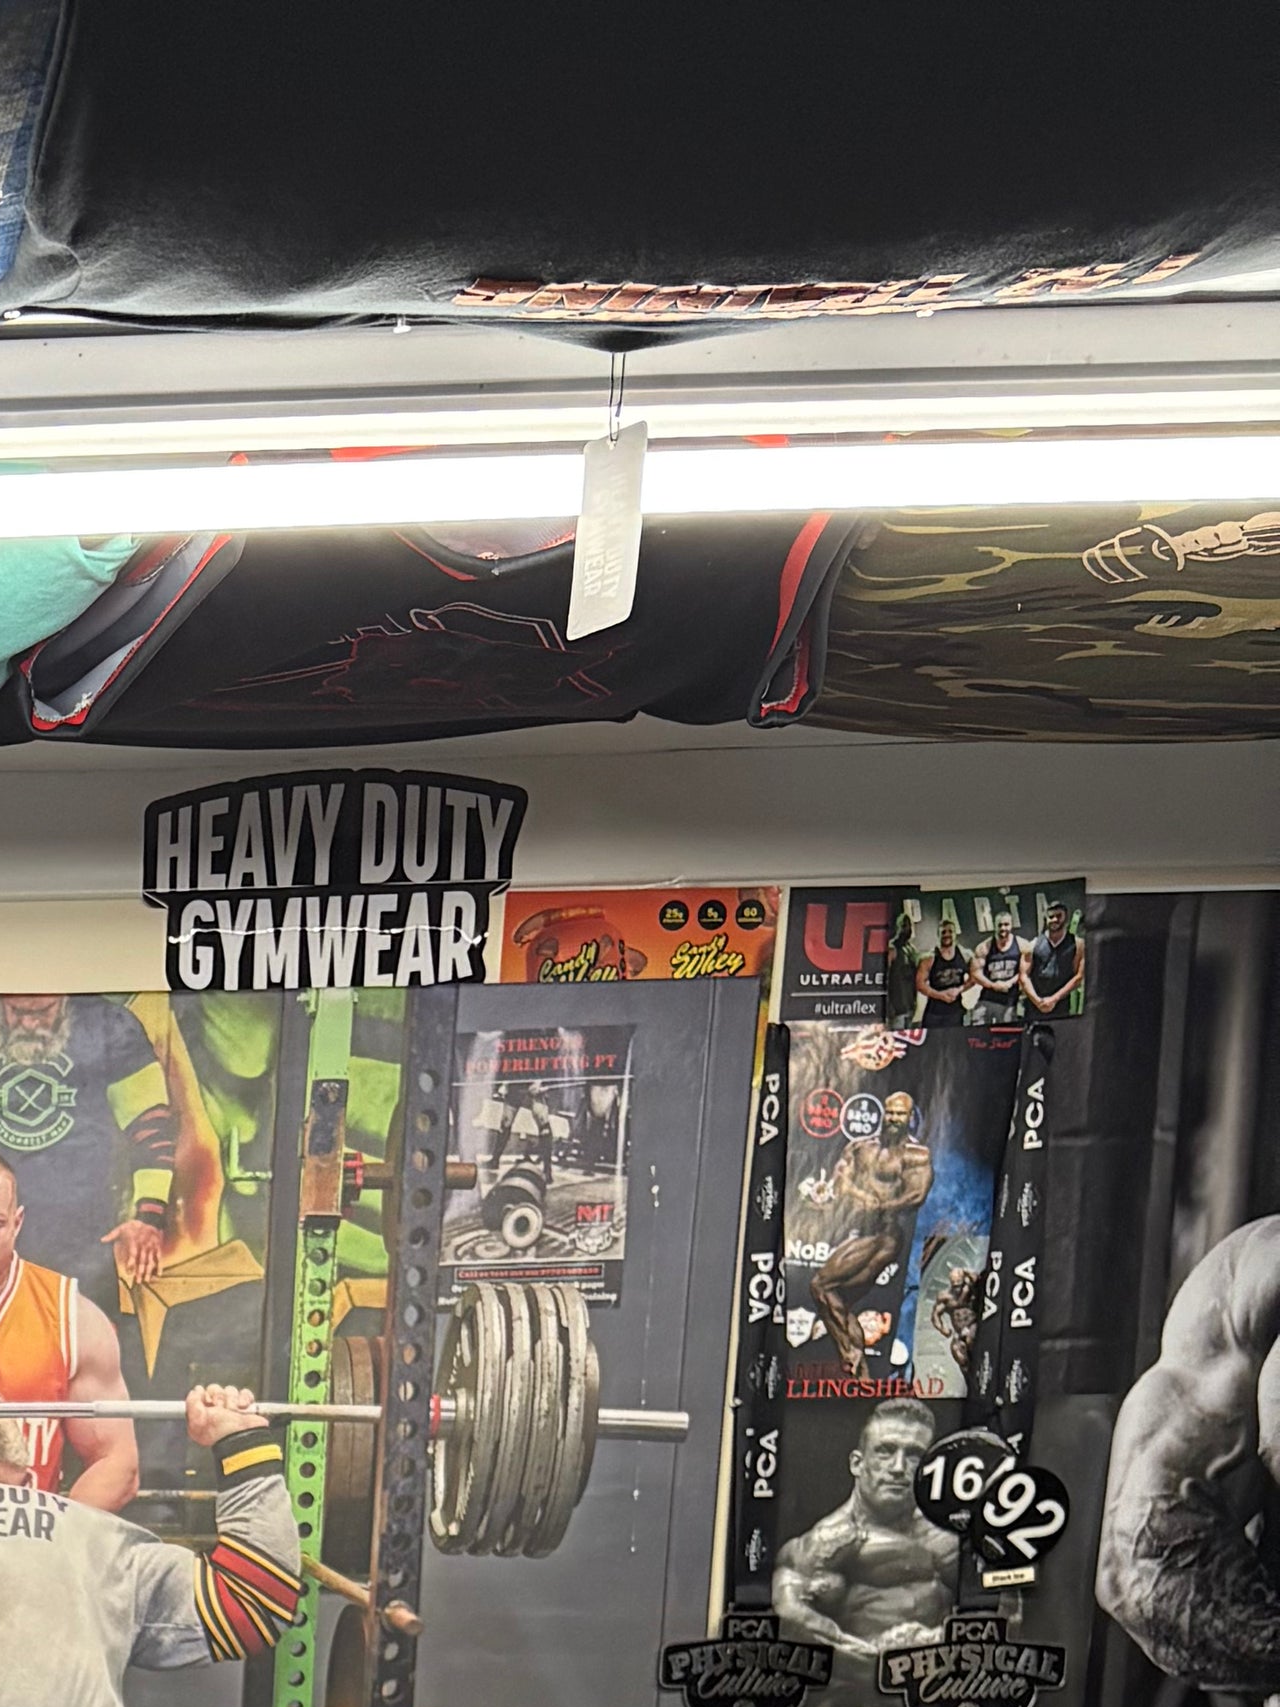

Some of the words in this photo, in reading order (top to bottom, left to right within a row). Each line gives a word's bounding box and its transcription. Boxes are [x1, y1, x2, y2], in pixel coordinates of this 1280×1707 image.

[157, 782, 345, 892] HEAVY
[360, 782, 514, 886] DUTY
[179, 890, 476, 991] GYMWEAR
[800, 973, 885, 987] ULTRAFLE
[814, 1001, 876, 1017] #ultraflex
[594, 1054, 617, 1069] PT
[758, 1073, 781, 1146] PCA
[1024, 1077, 1045, 1150] PCA
[748, 1252, 774, 1324] PCA
[981, 1250, 1003, 1321] PCA
[1010, 1256, 1036, 1328] PCA
[753, 1428, 780, 1498] PCA
[728, 1618, 775, 1641] PCA
[951, 1619, 1002, 1643] PCA
[667, 1644, 830, 1686] PHYSICAL
[887, 1644, 1061, 1687] PHYSICAL
